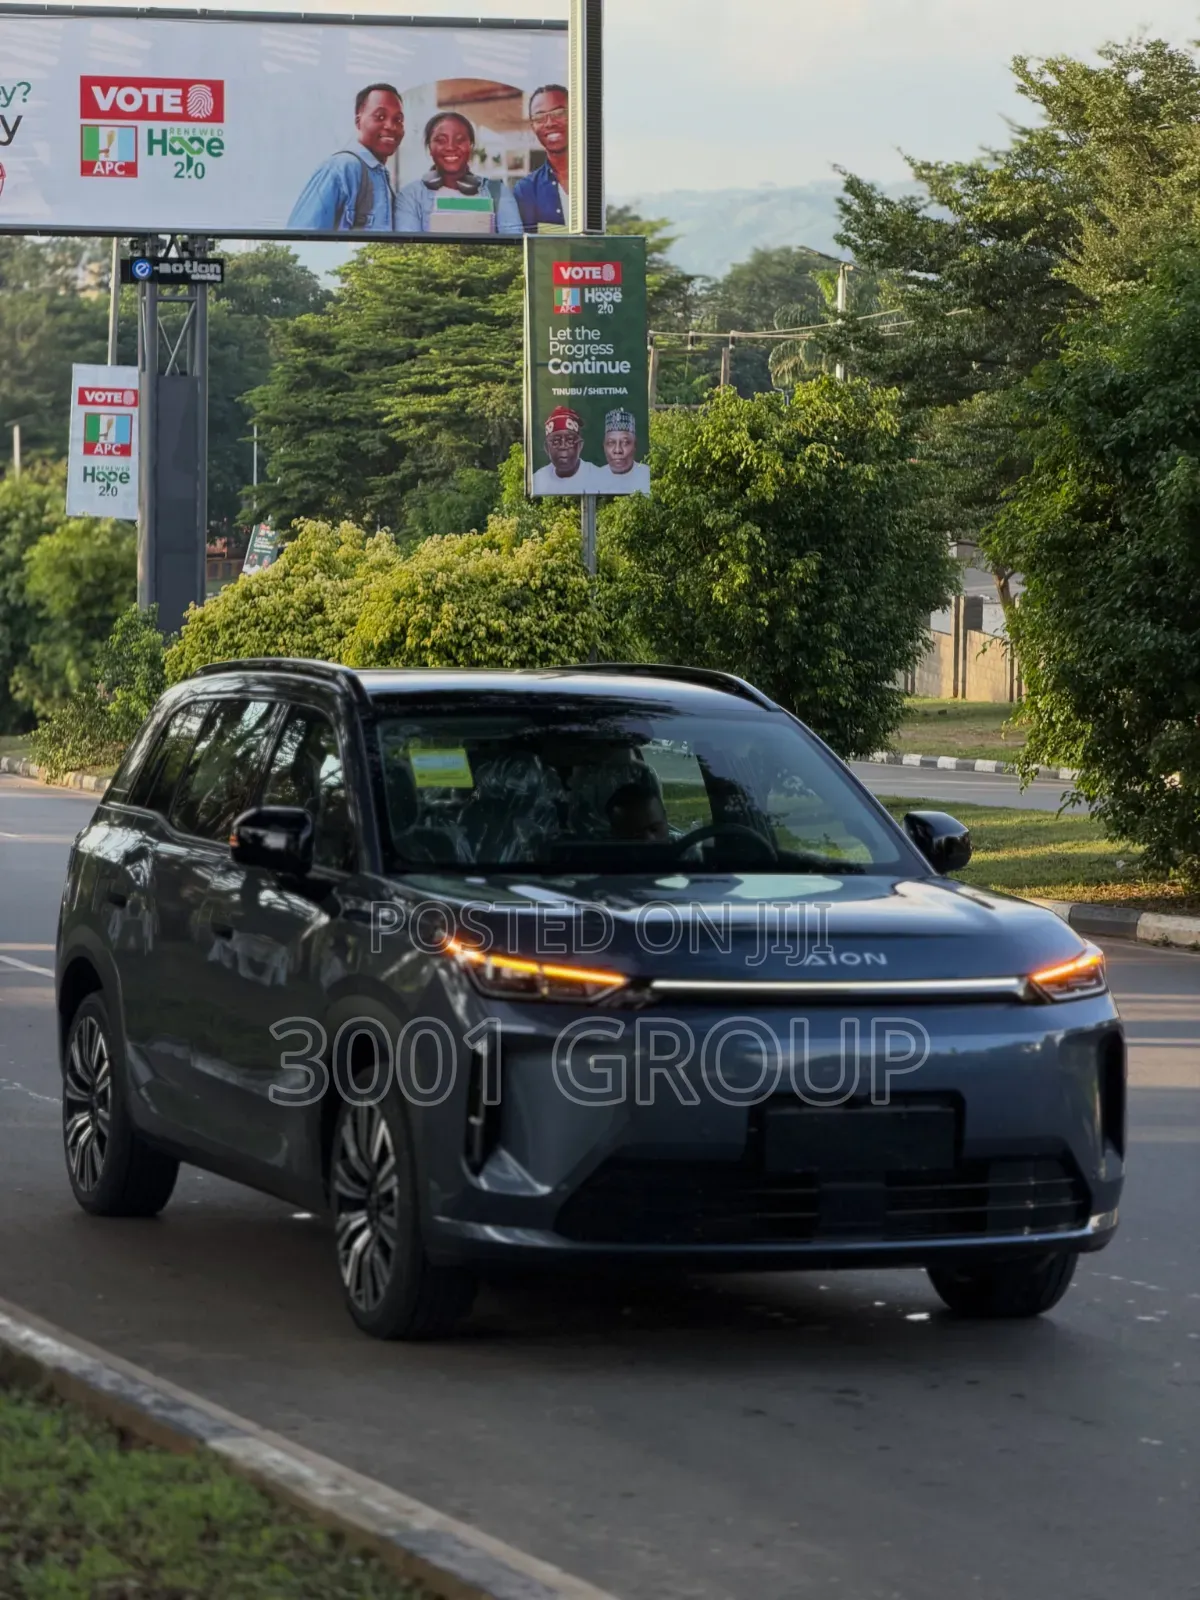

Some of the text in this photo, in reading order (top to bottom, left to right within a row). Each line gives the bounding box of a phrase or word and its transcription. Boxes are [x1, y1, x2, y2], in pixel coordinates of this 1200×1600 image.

[0, 81, 31, 108] y?
[91, 85, 183, 114] VOTE
[169, 127, 224, 136] RENEWED
[147, 128, 224, 172] Hope
[92, 161, 126, 176] APC
[174, 161, 205, 179] 2.0
[559, 266, 602, 280] VOTE
[584, 287, 623, 310] Hope
[559, 305, 576, 313] APC
[597, 303, 614, 314] 2.0
[549, 326, 601, 341] Let the
[549, 341, 614, 359] Progress
[548, 356, 631, 374] Continue
[84, 390, 123, 403] VOTE
[552, 387, 583, 396] TINUBU
[588, 387, 628, 395] SHETTIMA
[93, 443, 121, 455] APC
[83, 466, 130, 493] Hope
[99, 485, 118, 497] 2.0
[804, 952, 888, 966] AION
